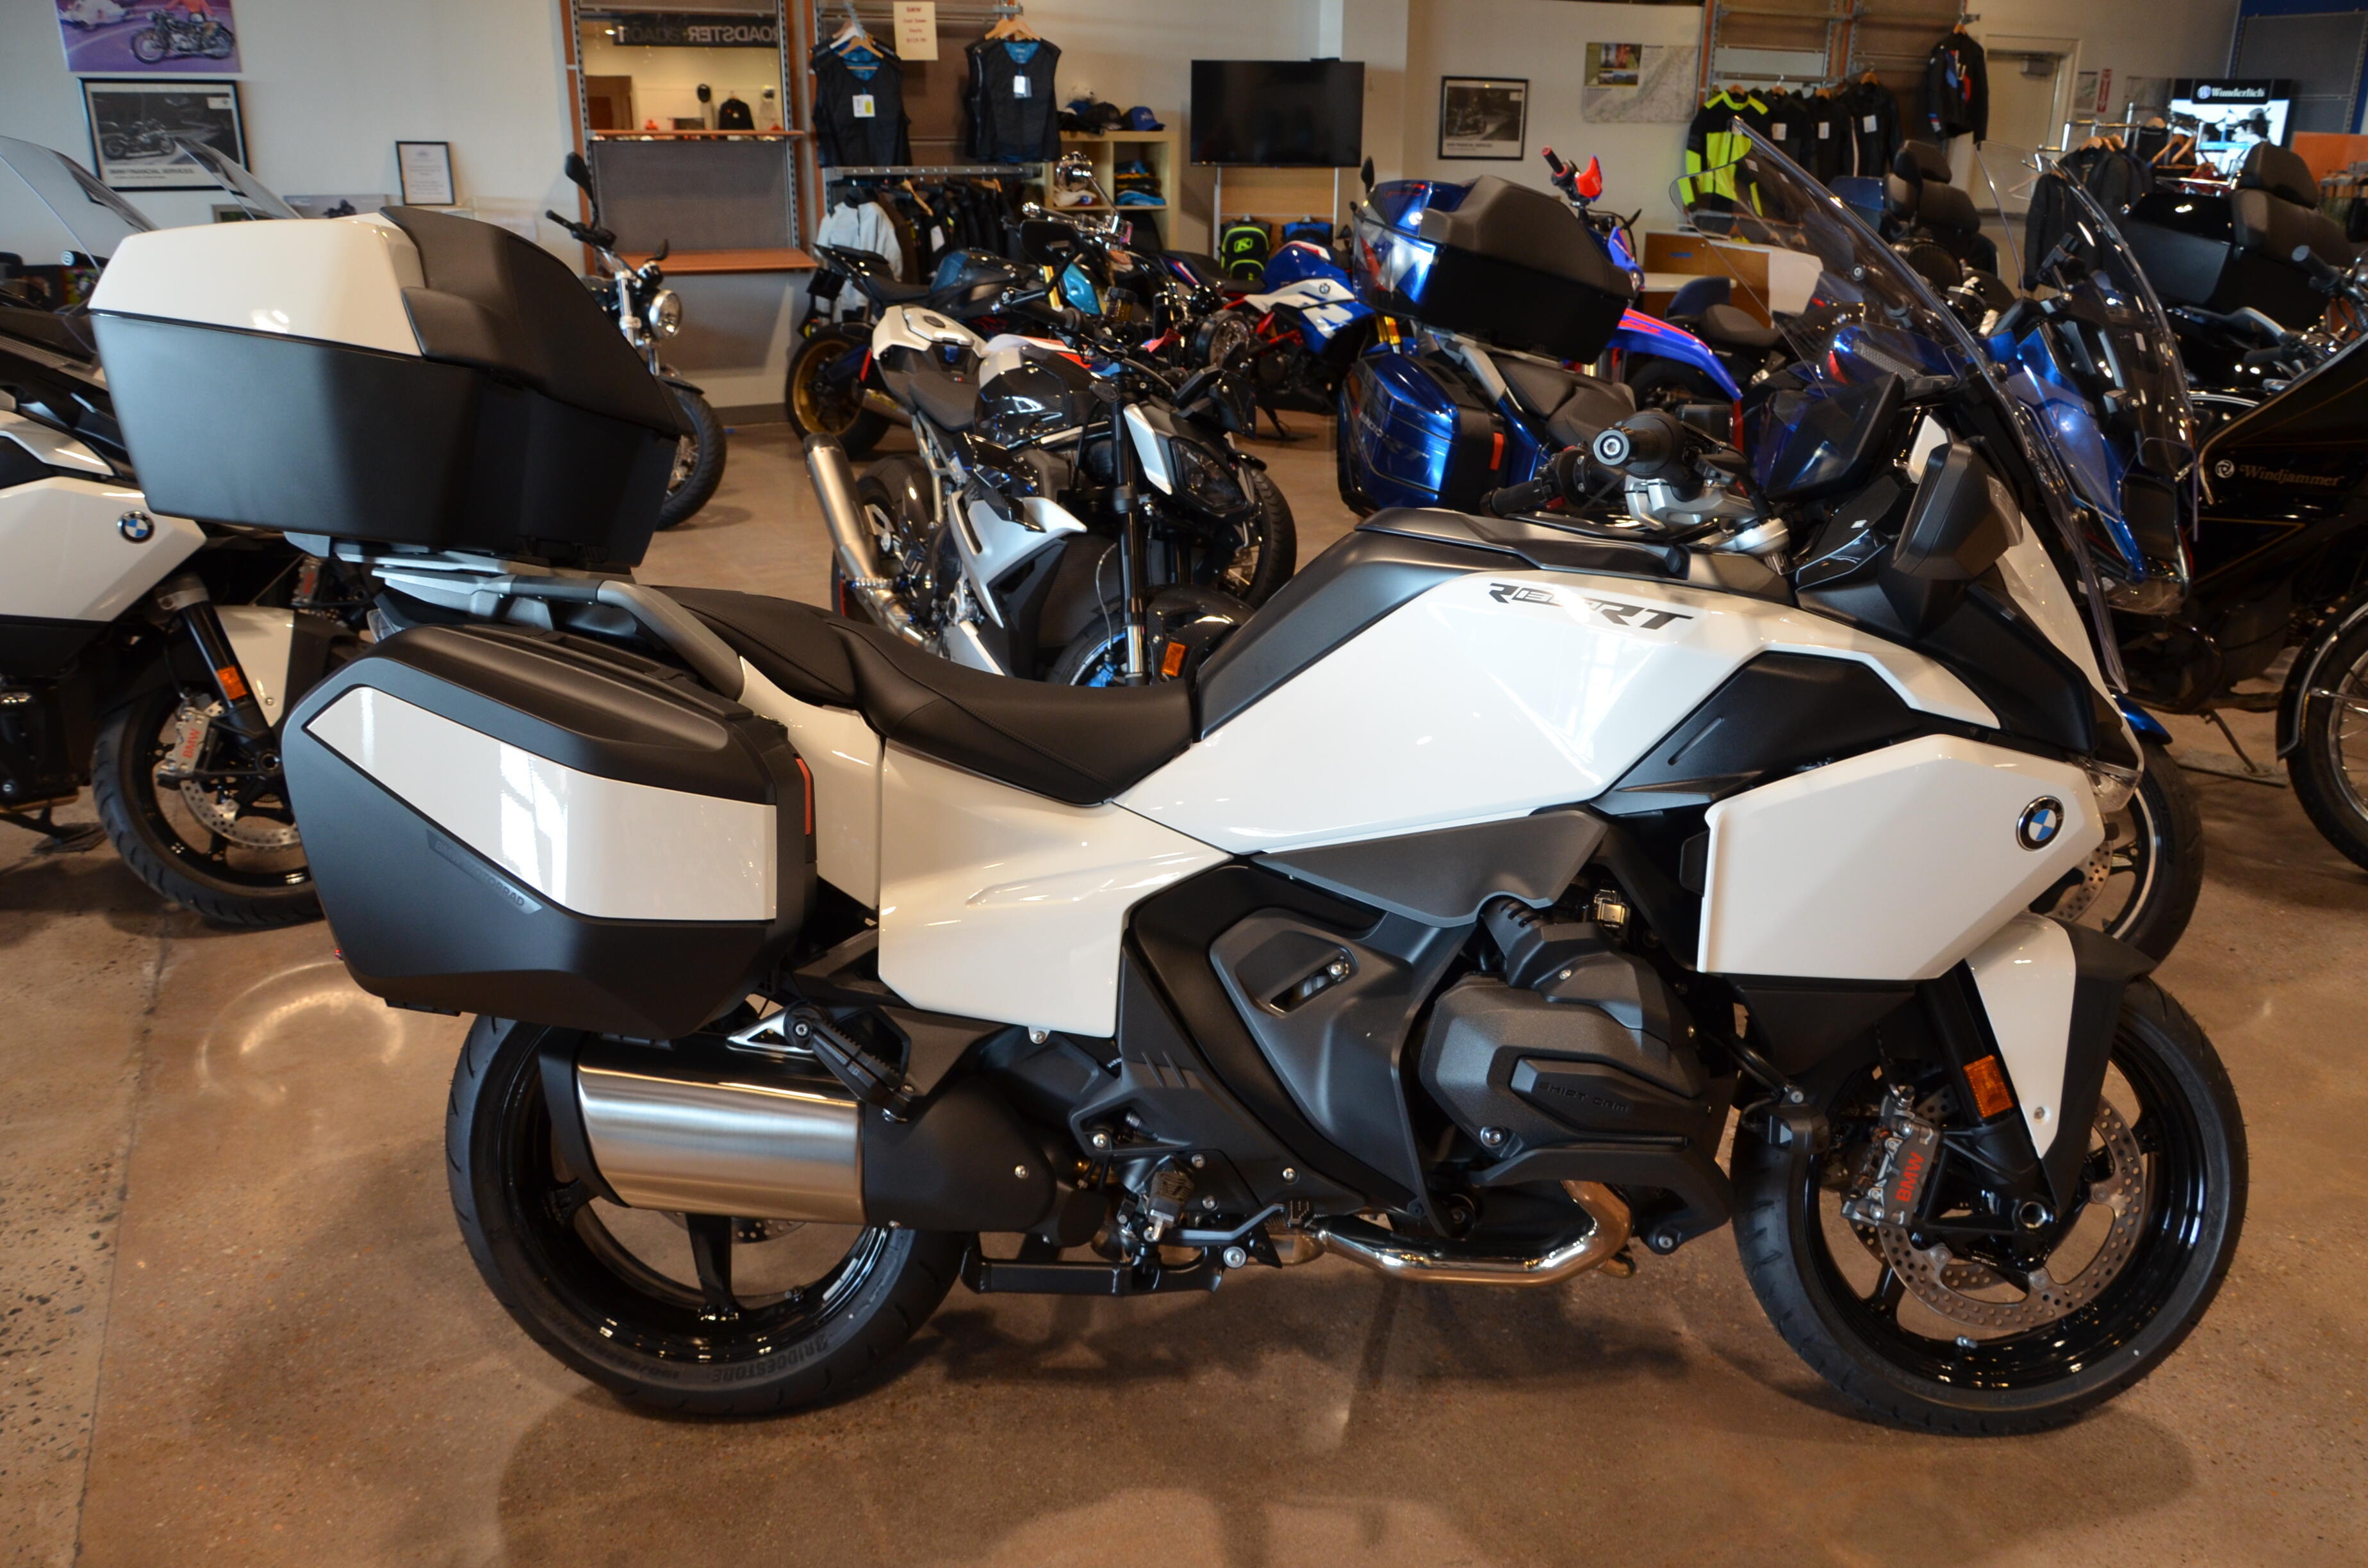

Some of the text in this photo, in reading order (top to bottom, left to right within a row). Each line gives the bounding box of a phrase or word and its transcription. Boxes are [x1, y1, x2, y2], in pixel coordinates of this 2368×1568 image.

[2212, 87, 2265, 97] Wunderlich
[2239, 464, 2346, 487] Windjammer
[1488, 582, 1695, 630] R13RT
[466, 860, 525, 907] OTORRAD
[1538, 1081, 1588, 1101] SHIFT
[1895, 1151, 1924, 1202] BMW
[711, 1334, 829, 1383] BRIDGESTONE
